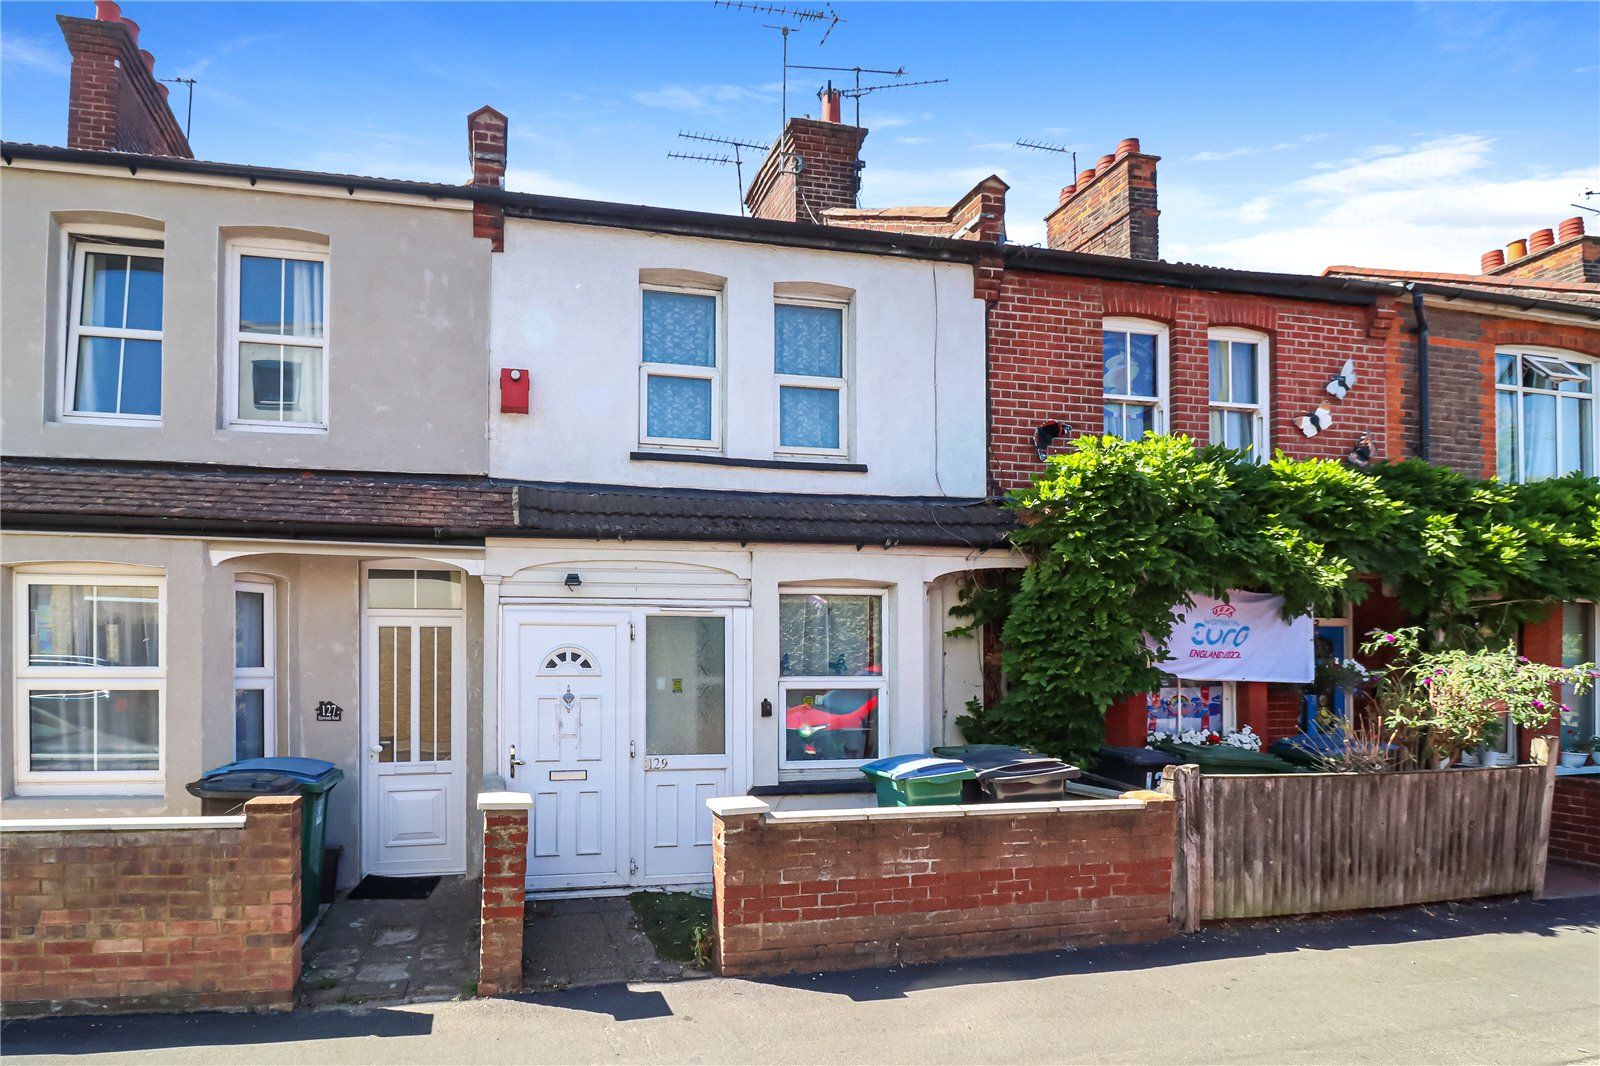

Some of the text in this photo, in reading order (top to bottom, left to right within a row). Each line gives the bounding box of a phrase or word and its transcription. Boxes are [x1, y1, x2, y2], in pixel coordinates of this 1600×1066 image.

[1212, 605, 1235, 617] UEFA
[322, 705, 336, 716] 127
[648, 757, 668, 770] 129
